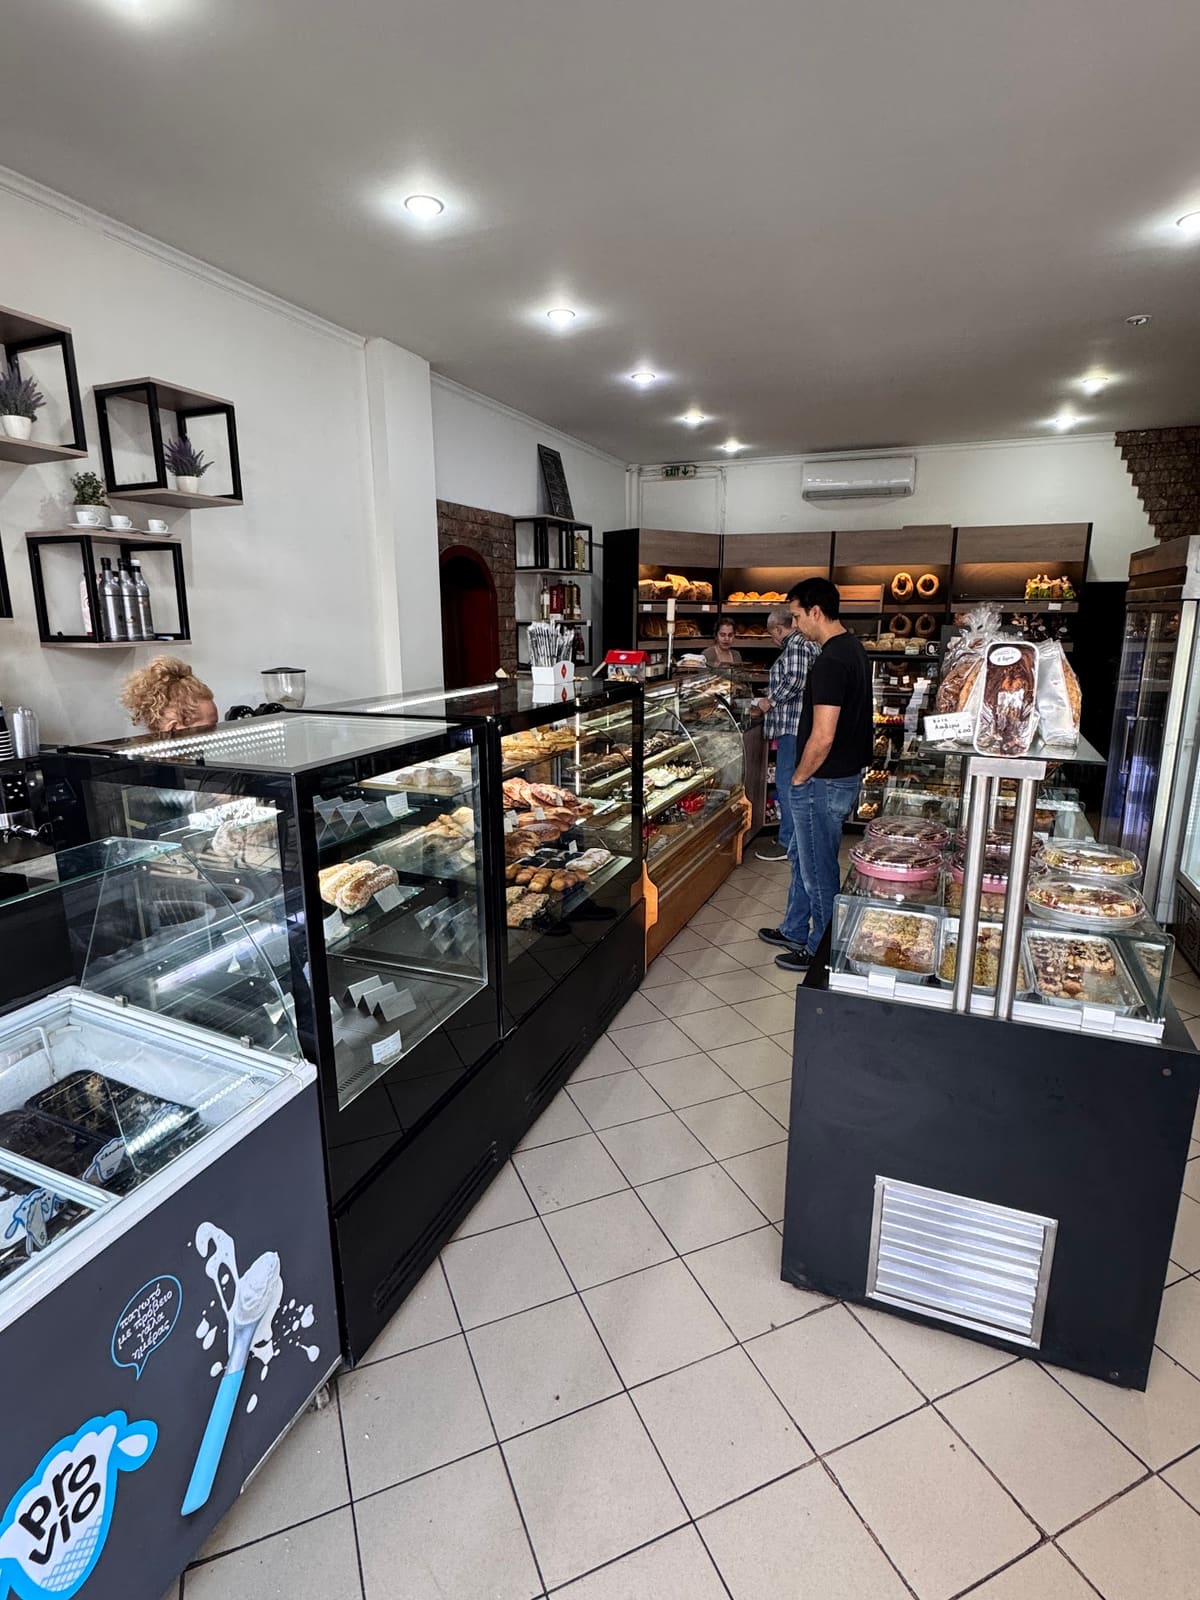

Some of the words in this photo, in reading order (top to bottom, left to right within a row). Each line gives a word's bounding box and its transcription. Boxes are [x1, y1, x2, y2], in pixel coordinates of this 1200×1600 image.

[665, 466, 680, 477] EXIT
[118, 1328, 132, 1350] με
[133, 1290, 173, 1329] πρόβειο
[120, 1283, 161, 1329] παγωτό
[137, 1311, 165, 1342] γάλα
[131, 1319, 170, 1359] ημέρας
[18, 1454, 97, 1541] pro
[28, 1482, 101, 1565] vio
